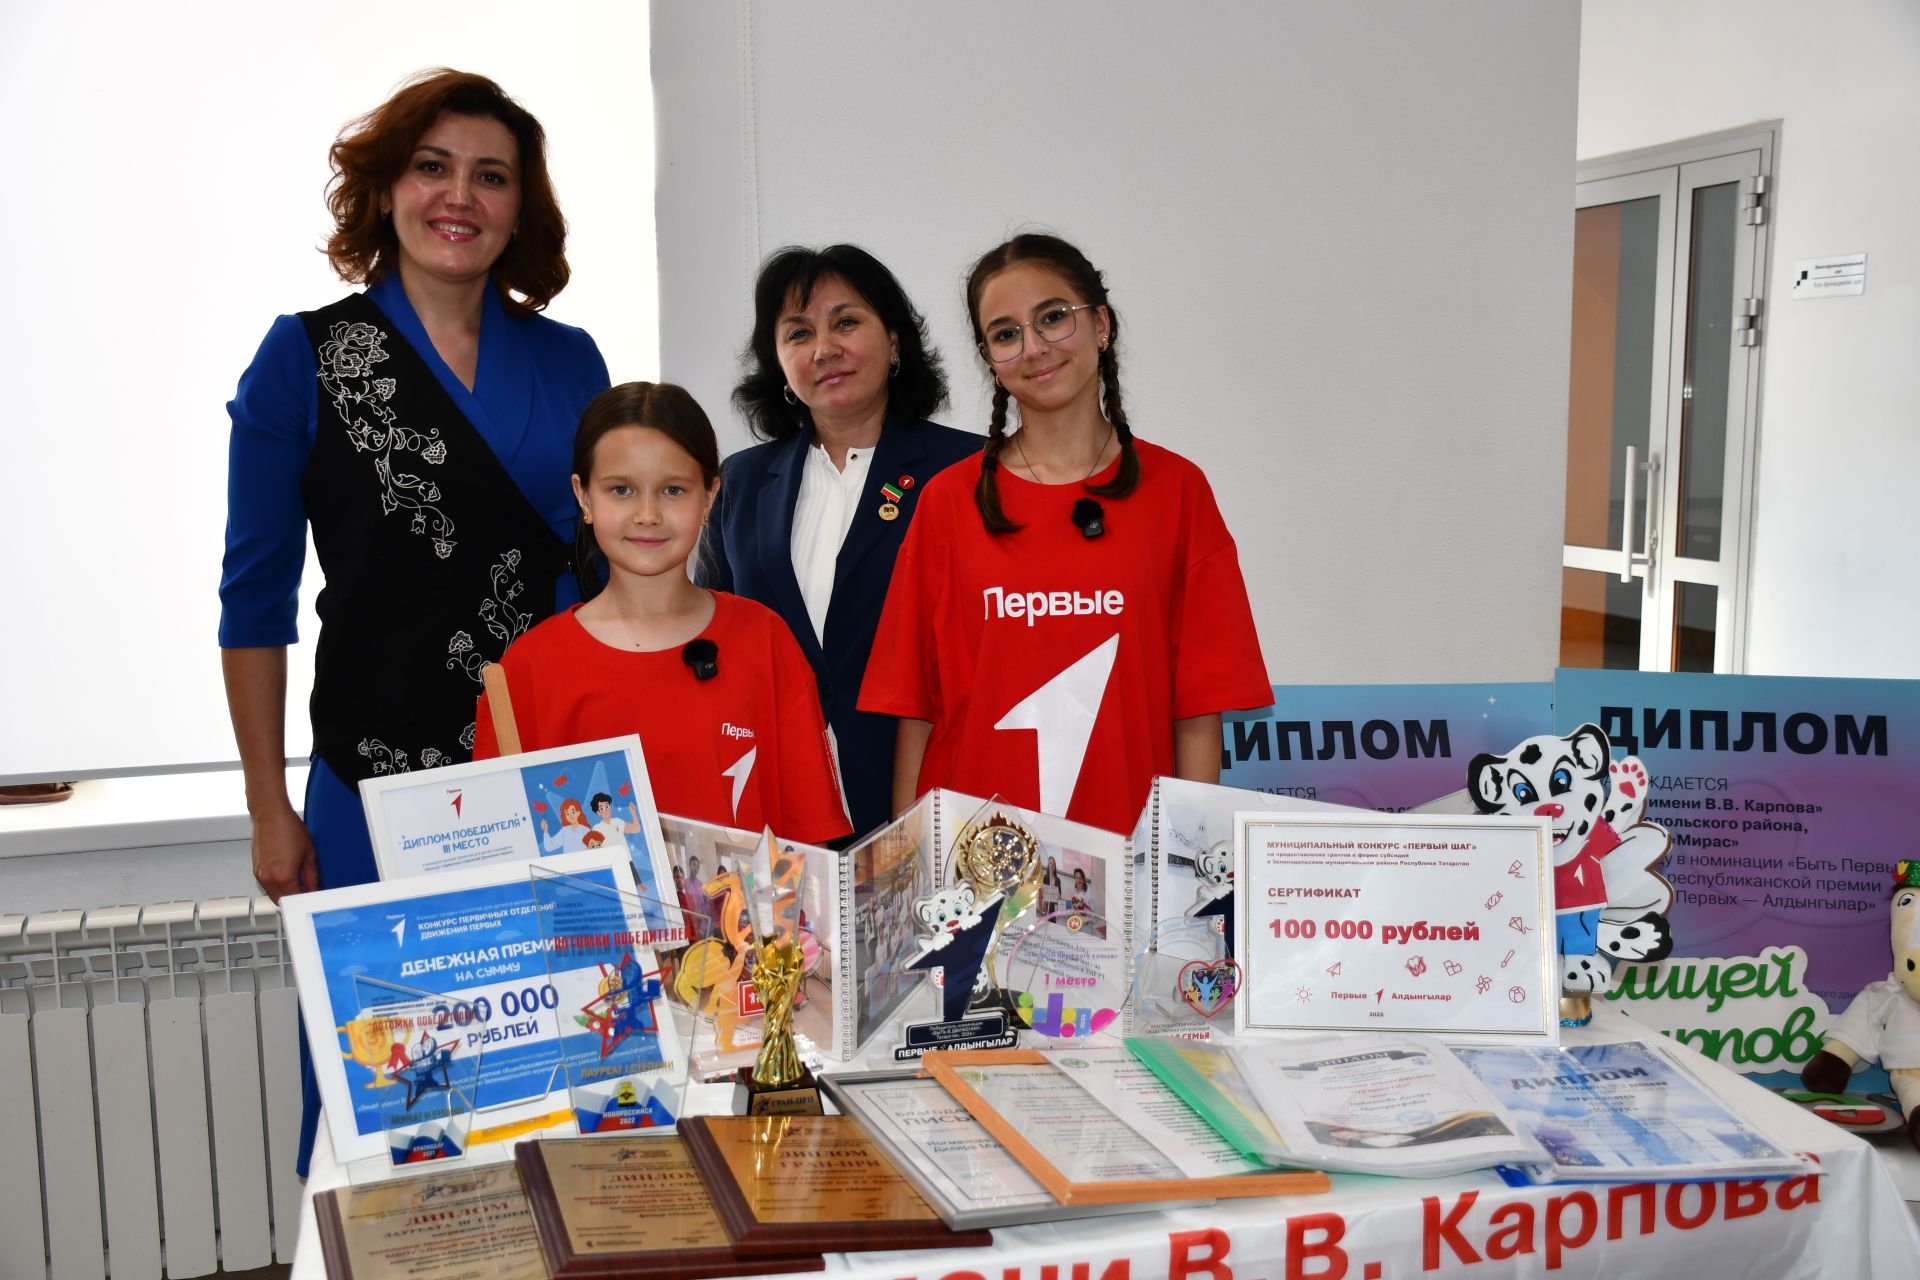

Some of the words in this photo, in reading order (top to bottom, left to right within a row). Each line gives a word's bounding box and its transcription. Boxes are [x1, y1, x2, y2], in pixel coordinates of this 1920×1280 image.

[983, 586, 1124, 627] Первые
[721, 723, 755, 740] Первы
[1600, 706, 1888, 756] ДИПЛОМ
[1649, 798, 1701, 810] имени
[1705, 800, 1739, 812] В.В.
[1744, 800, 1823, 814] Карпова»
[1742, 816, 1808, 833] района,
[403, 832, 451, 850] ДИПЛОМ
[452, 819, 520, 839] ПОБЕДИТЕЛЯ
[453, 837, 489, 852] МЕСТО
[1267, 841, 1354, 849] МУНИЦИПАЛЬНЫЙ
[1357, 842, 1400, 850] КОНКУРС
[1403, 842, 1448, 850] «ПЕРВЫЙ
[1676, 856, 1685, 865] в
[1689, 856, 1783, 870] номинации
[1787, 857, 1837, 871] «Быть
[1841, 858, 1899, 874] Первы
[1268, 888, 1361, 898] СЕРТИФИКАТ
[1667, 873, 1811, 889] республиканской
[1816, 878, 1882, 894] премии
[1676, 890, 1737, 907] Первых
[1763, 894, 1876, 913] Алдынгылар»
[418, 918, 458, 930] КОНКУРС
[459, 911, 508, 924] ПЕРВИЧНЫХ
[421, 925, 468, 940] ДВИЖЕНИЯ
[469, 920, 502, 932] ПЕРВЫХ
[1269, 919, 1316, 938] 100
[1324, 920, 1373, 939] 000
[1382, 921, 1479, 944] рублей
[401, 947, 500, 977] ДЕНЕЖНАЯ
[455, 971, 474, 982] НА
[476, 962, 521, 978] СУММУ
[1056, 976, 1097, 986] место
[1331, 991, 1367, 1000] Первые
[1391, 992, 1451, 1003] Алдынгылар
[432, 997, 492, 1031] 200
[501, 984, 559, 1017] 000
[467, 1016, 539, 1047] РУБЛЕЙ
[947, 1037, 1013, 1051] АЛДЫНГЫЛАР
[1510, 1067, 1649, 1090] ДИПЛОМ
[603, 1107, 653, 1118] НОВОРОССИЙСК
[620, 1117, 636, 1125] 2022
[477, 1209, 530, 1223] СТЕПЕН
[1420, 1152, 1823, 1271] Карпова
